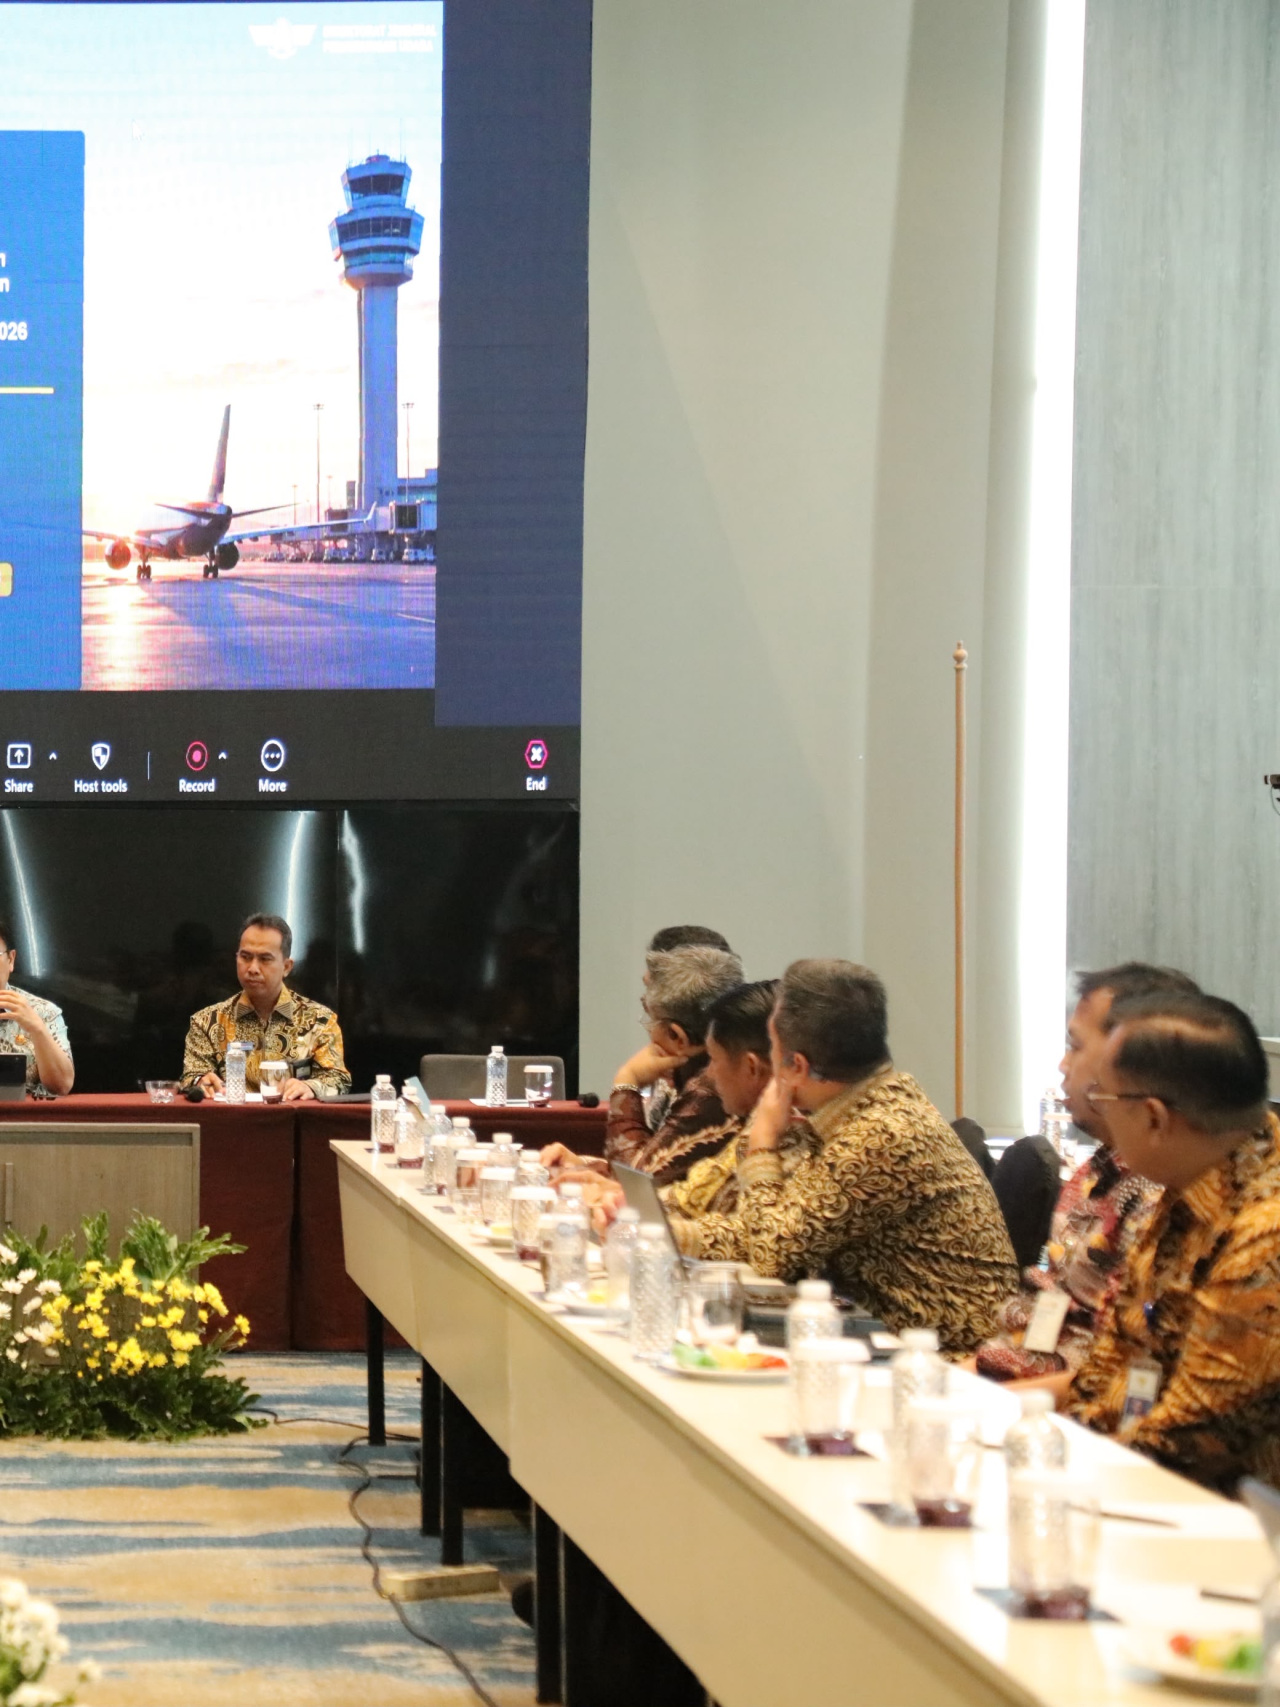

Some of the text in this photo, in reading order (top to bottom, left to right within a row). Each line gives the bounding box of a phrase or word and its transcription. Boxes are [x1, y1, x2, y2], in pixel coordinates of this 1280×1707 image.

[4, 780, 34, 793] Share
[74, 780, 128, 793] Host tools
[179, 779, 215, 793] Record
[259, 779, 287, 792] More
[526, 777, 546, 791] End
